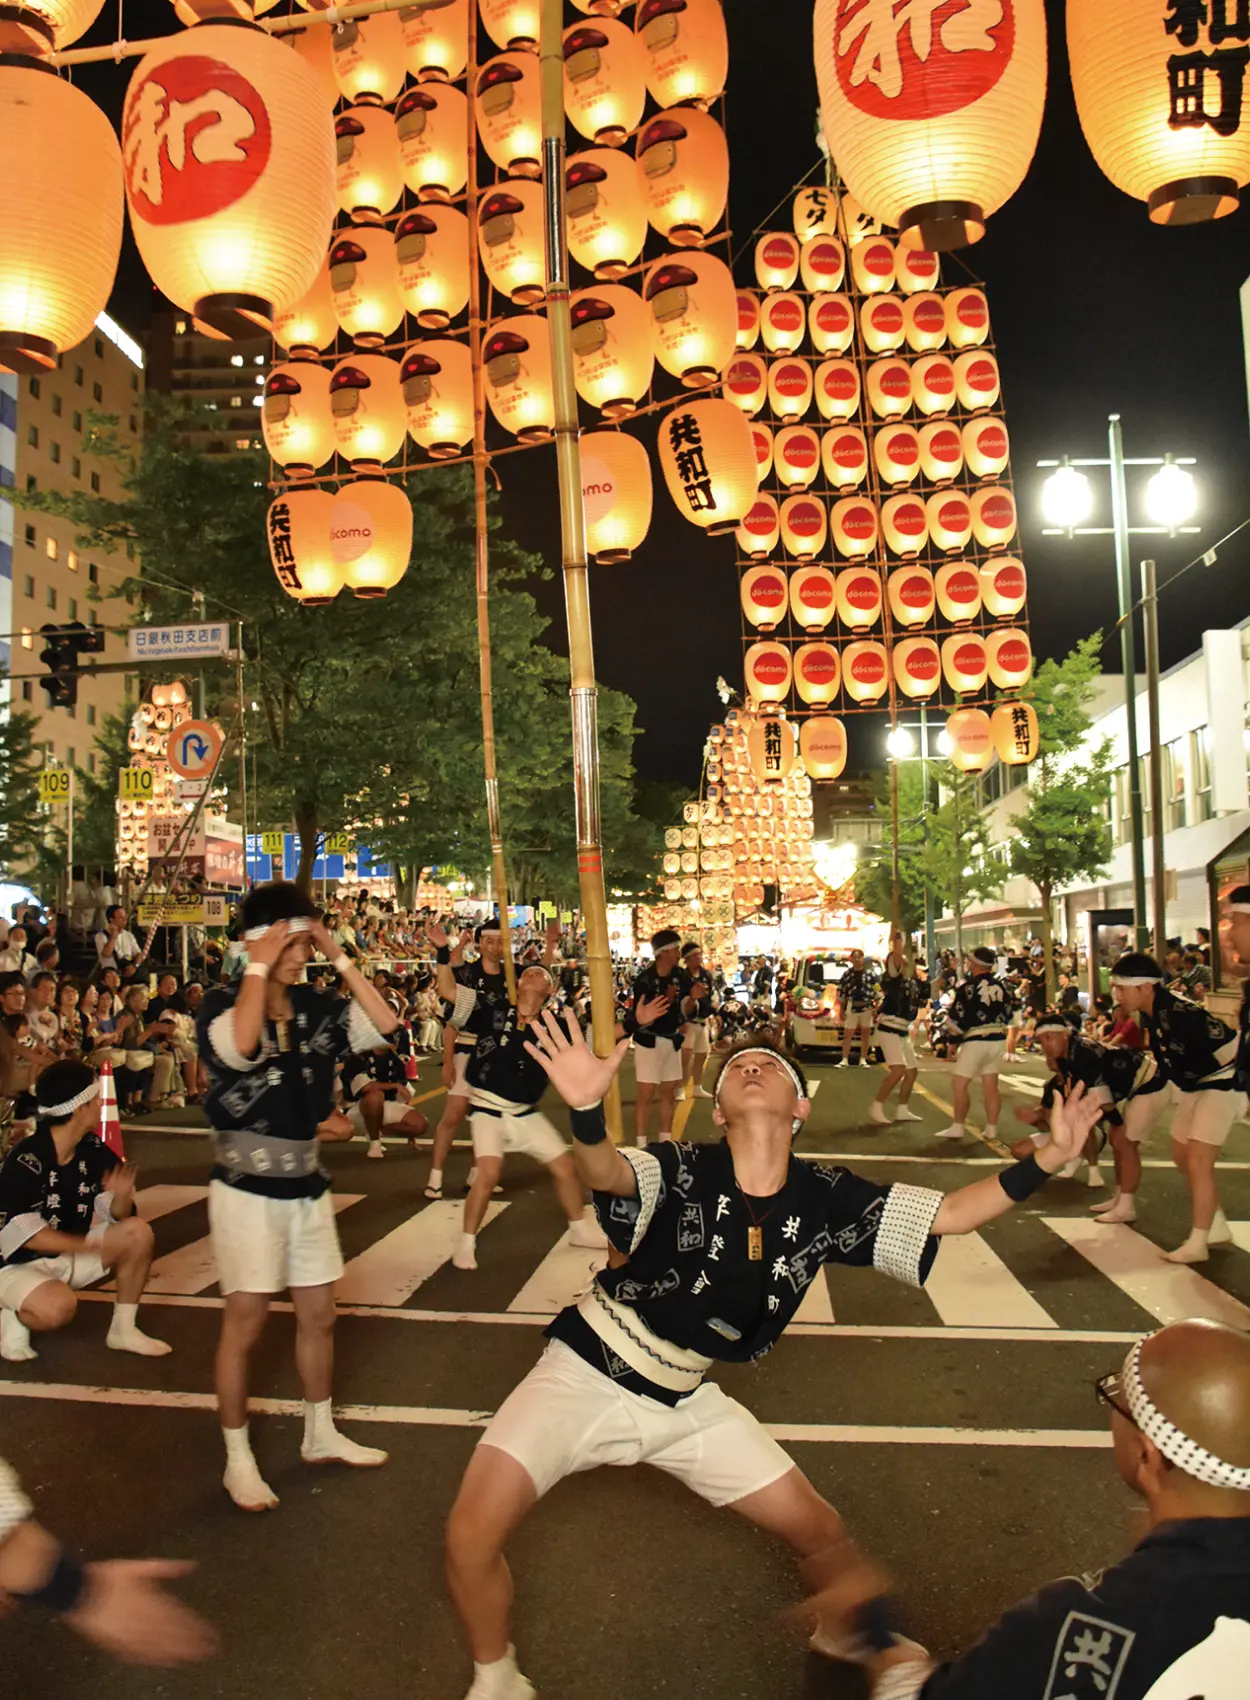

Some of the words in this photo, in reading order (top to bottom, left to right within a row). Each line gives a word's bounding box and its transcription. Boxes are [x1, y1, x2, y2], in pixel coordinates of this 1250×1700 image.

[668, 413, 718, 512] 共和町
[331, 527, 371, 540] como
[764, 722, 782, 770] 共和町
[1012, 707, 1030, 756] 共和町
[43, 773, 69, 792] 109
[125, 771, 152, 790] 110
[264, 833, 282, 847] 111
[328, 834, 347, 848] 112
[768, 1215, 801, 1315] 共和町
[1054, 1628, 1112, 1700] 共
